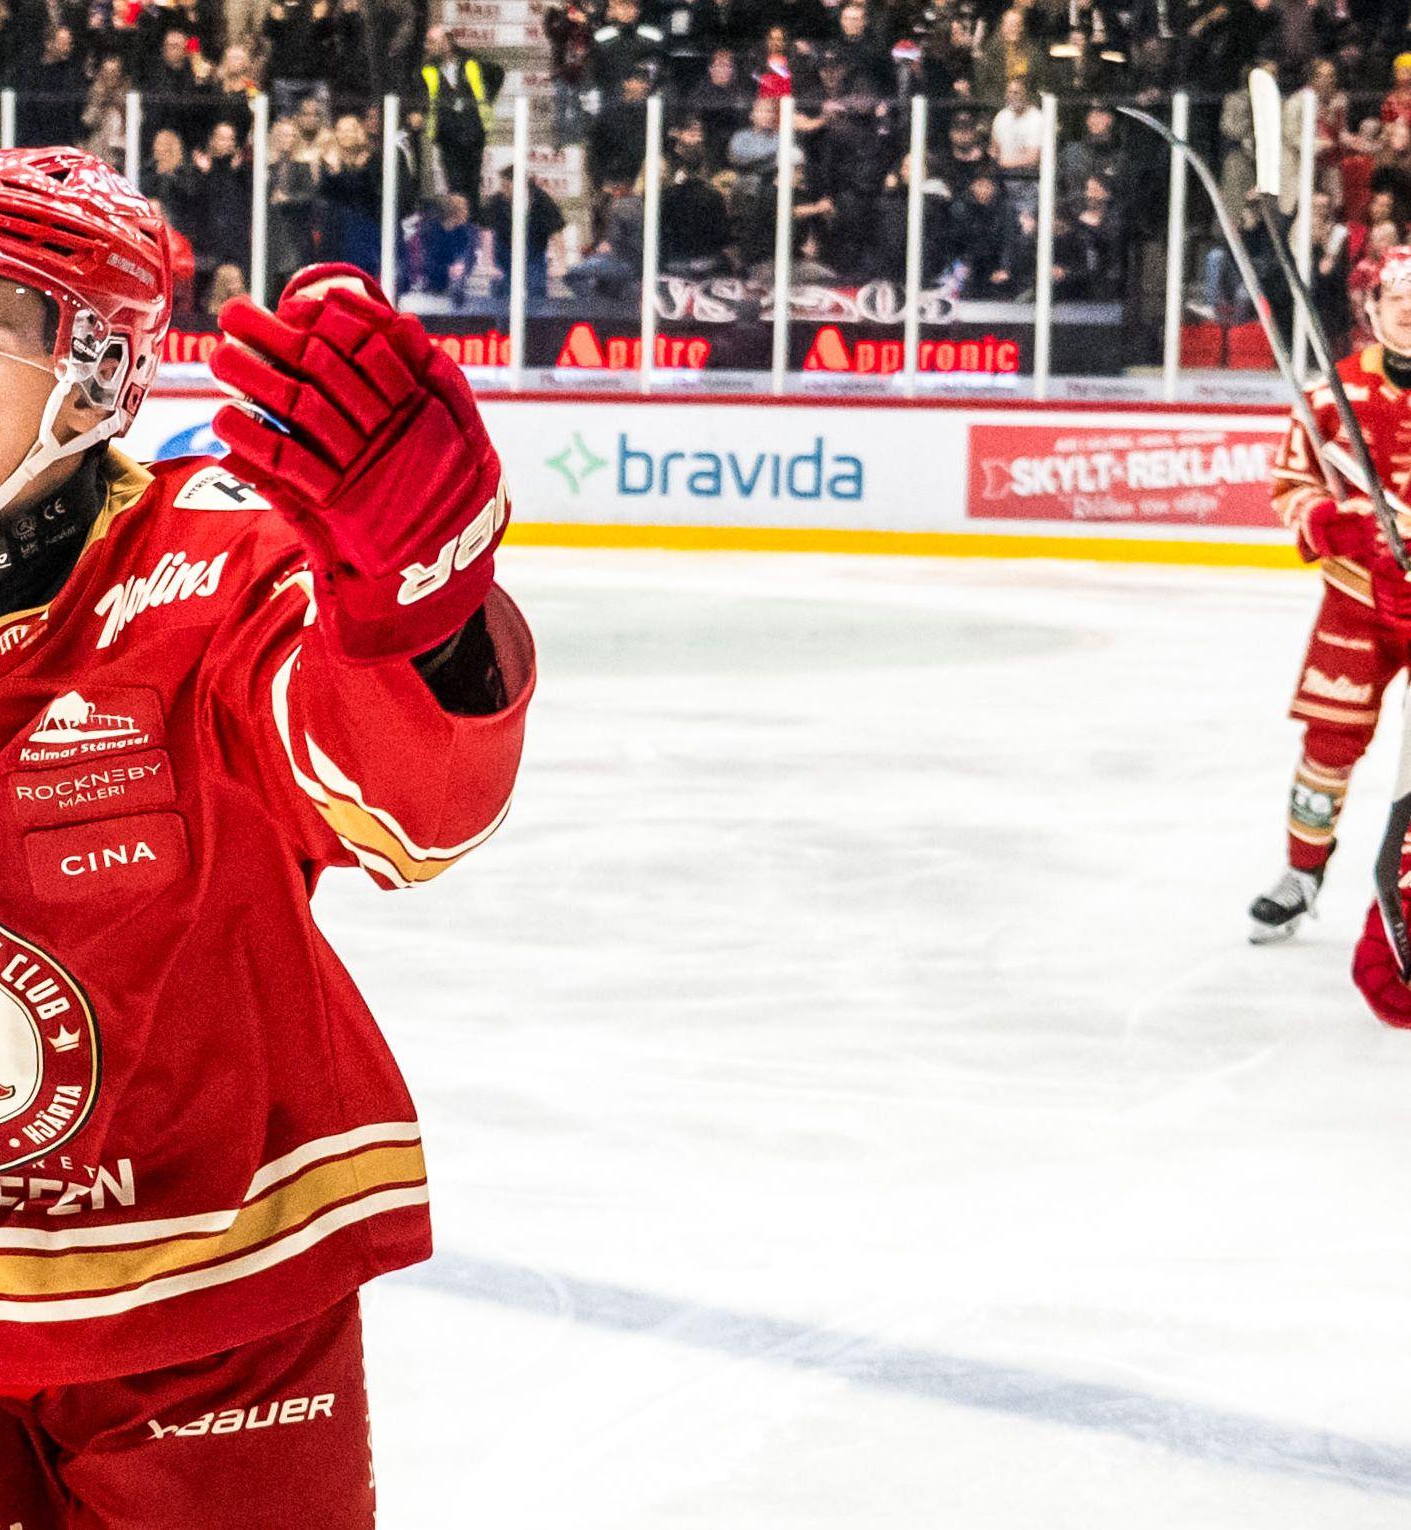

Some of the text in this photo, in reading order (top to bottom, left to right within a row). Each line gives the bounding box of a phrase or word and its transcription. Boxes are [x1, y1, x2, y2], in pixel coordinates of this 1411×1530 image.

[802, 326, 1019, 374] Appronic
[618, 432, 863, 500] bravida
[20, 734, 150, 762] Kalmar Stängsel
[16, 763, 161, 801] ROCKNEBY
[58, 785, 125, 810] MALERI
[60, 841, 157, 876] CINA
[0, 953, 71, 1020] CLUB
[21, 1084, 83, 1146] HJÄRTA
[175, 1392, 336, 1437] BAUER
